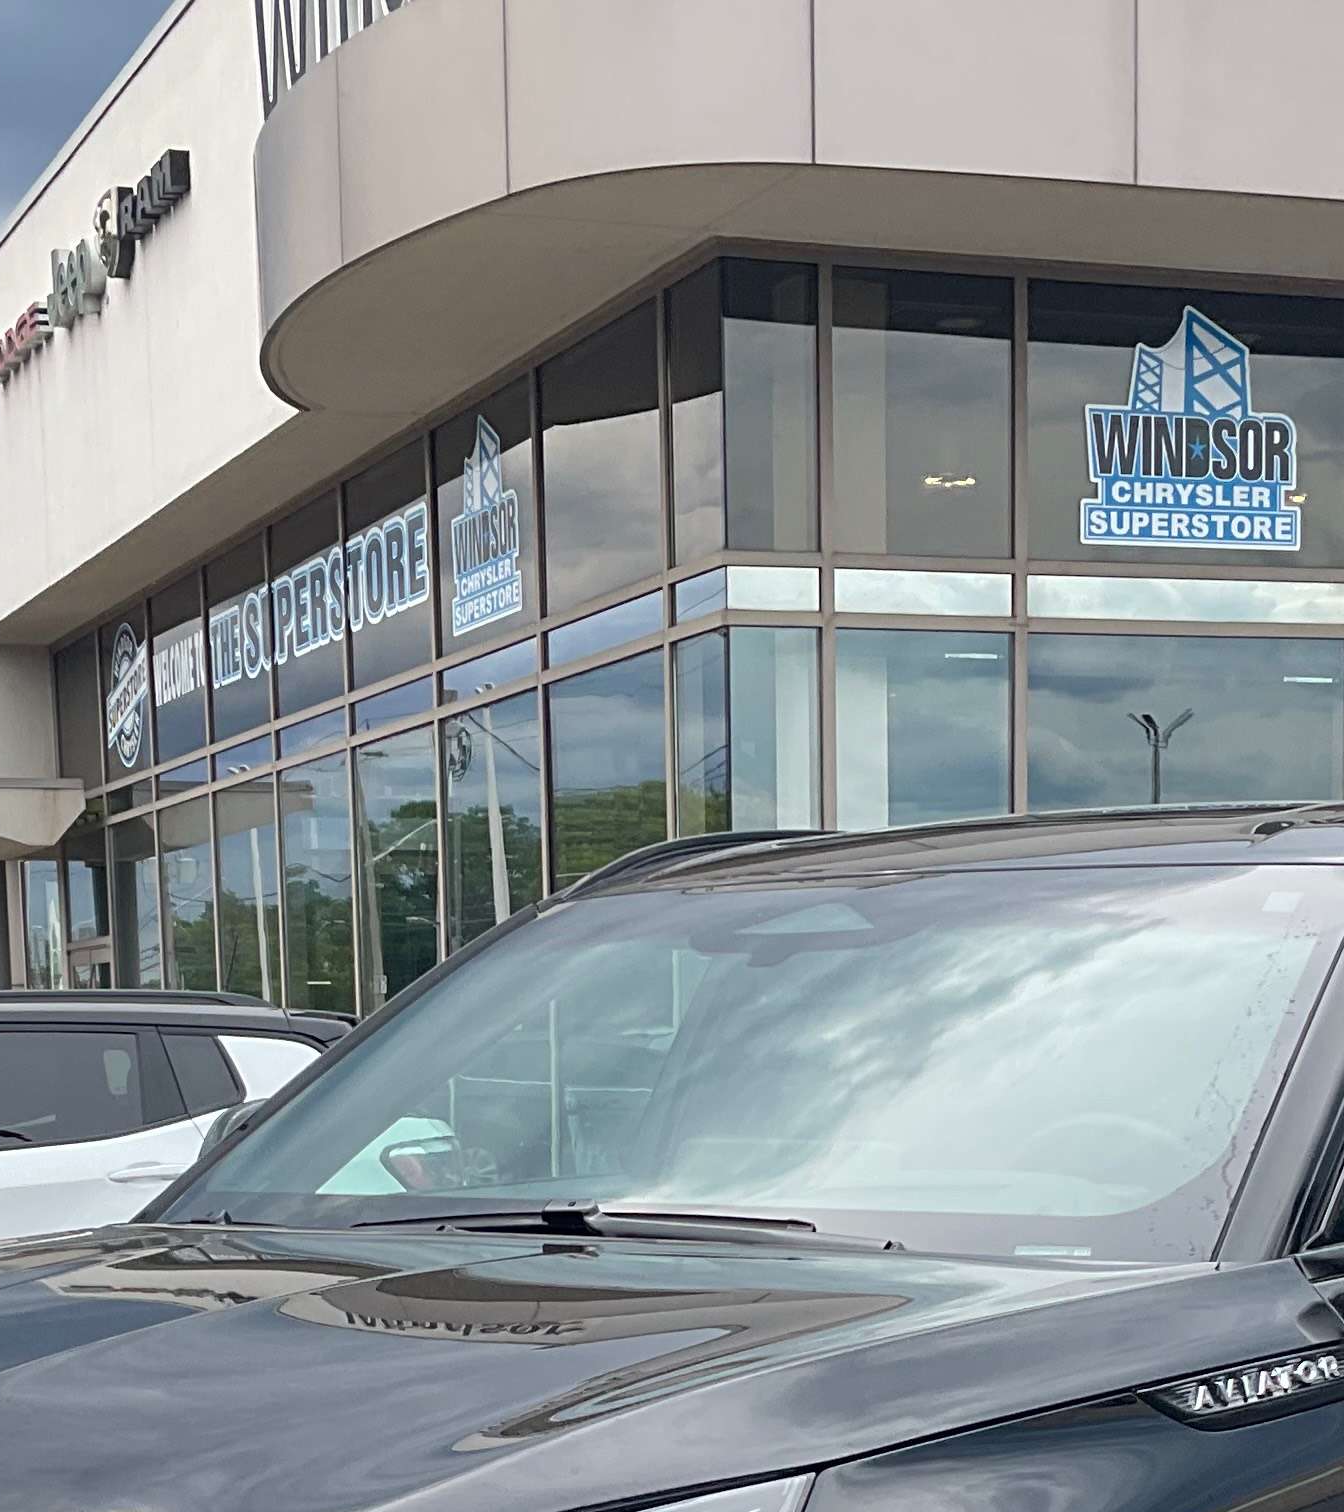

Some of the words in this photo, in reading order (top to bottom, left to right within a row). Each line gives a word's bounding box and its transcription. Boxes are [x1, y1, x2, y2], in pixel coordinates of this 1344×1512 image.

[1092, 413, 1292, 482] WINDSOR
[1111, 481, 1271, 508] CHRYSLER
[454, 498, 516, 575] WINDSOR
[1089, 510, 1293, 540] SUPERSTORE
[455, 582, 520, 626] SUPERSTORE
[461, 558, 512, 597] CHRYSLER
[153, 635, 194, 707] WELCOME
[210, 608, 241, 687] THE
[1190, 1355, 1342, 1412] AVIATOR
